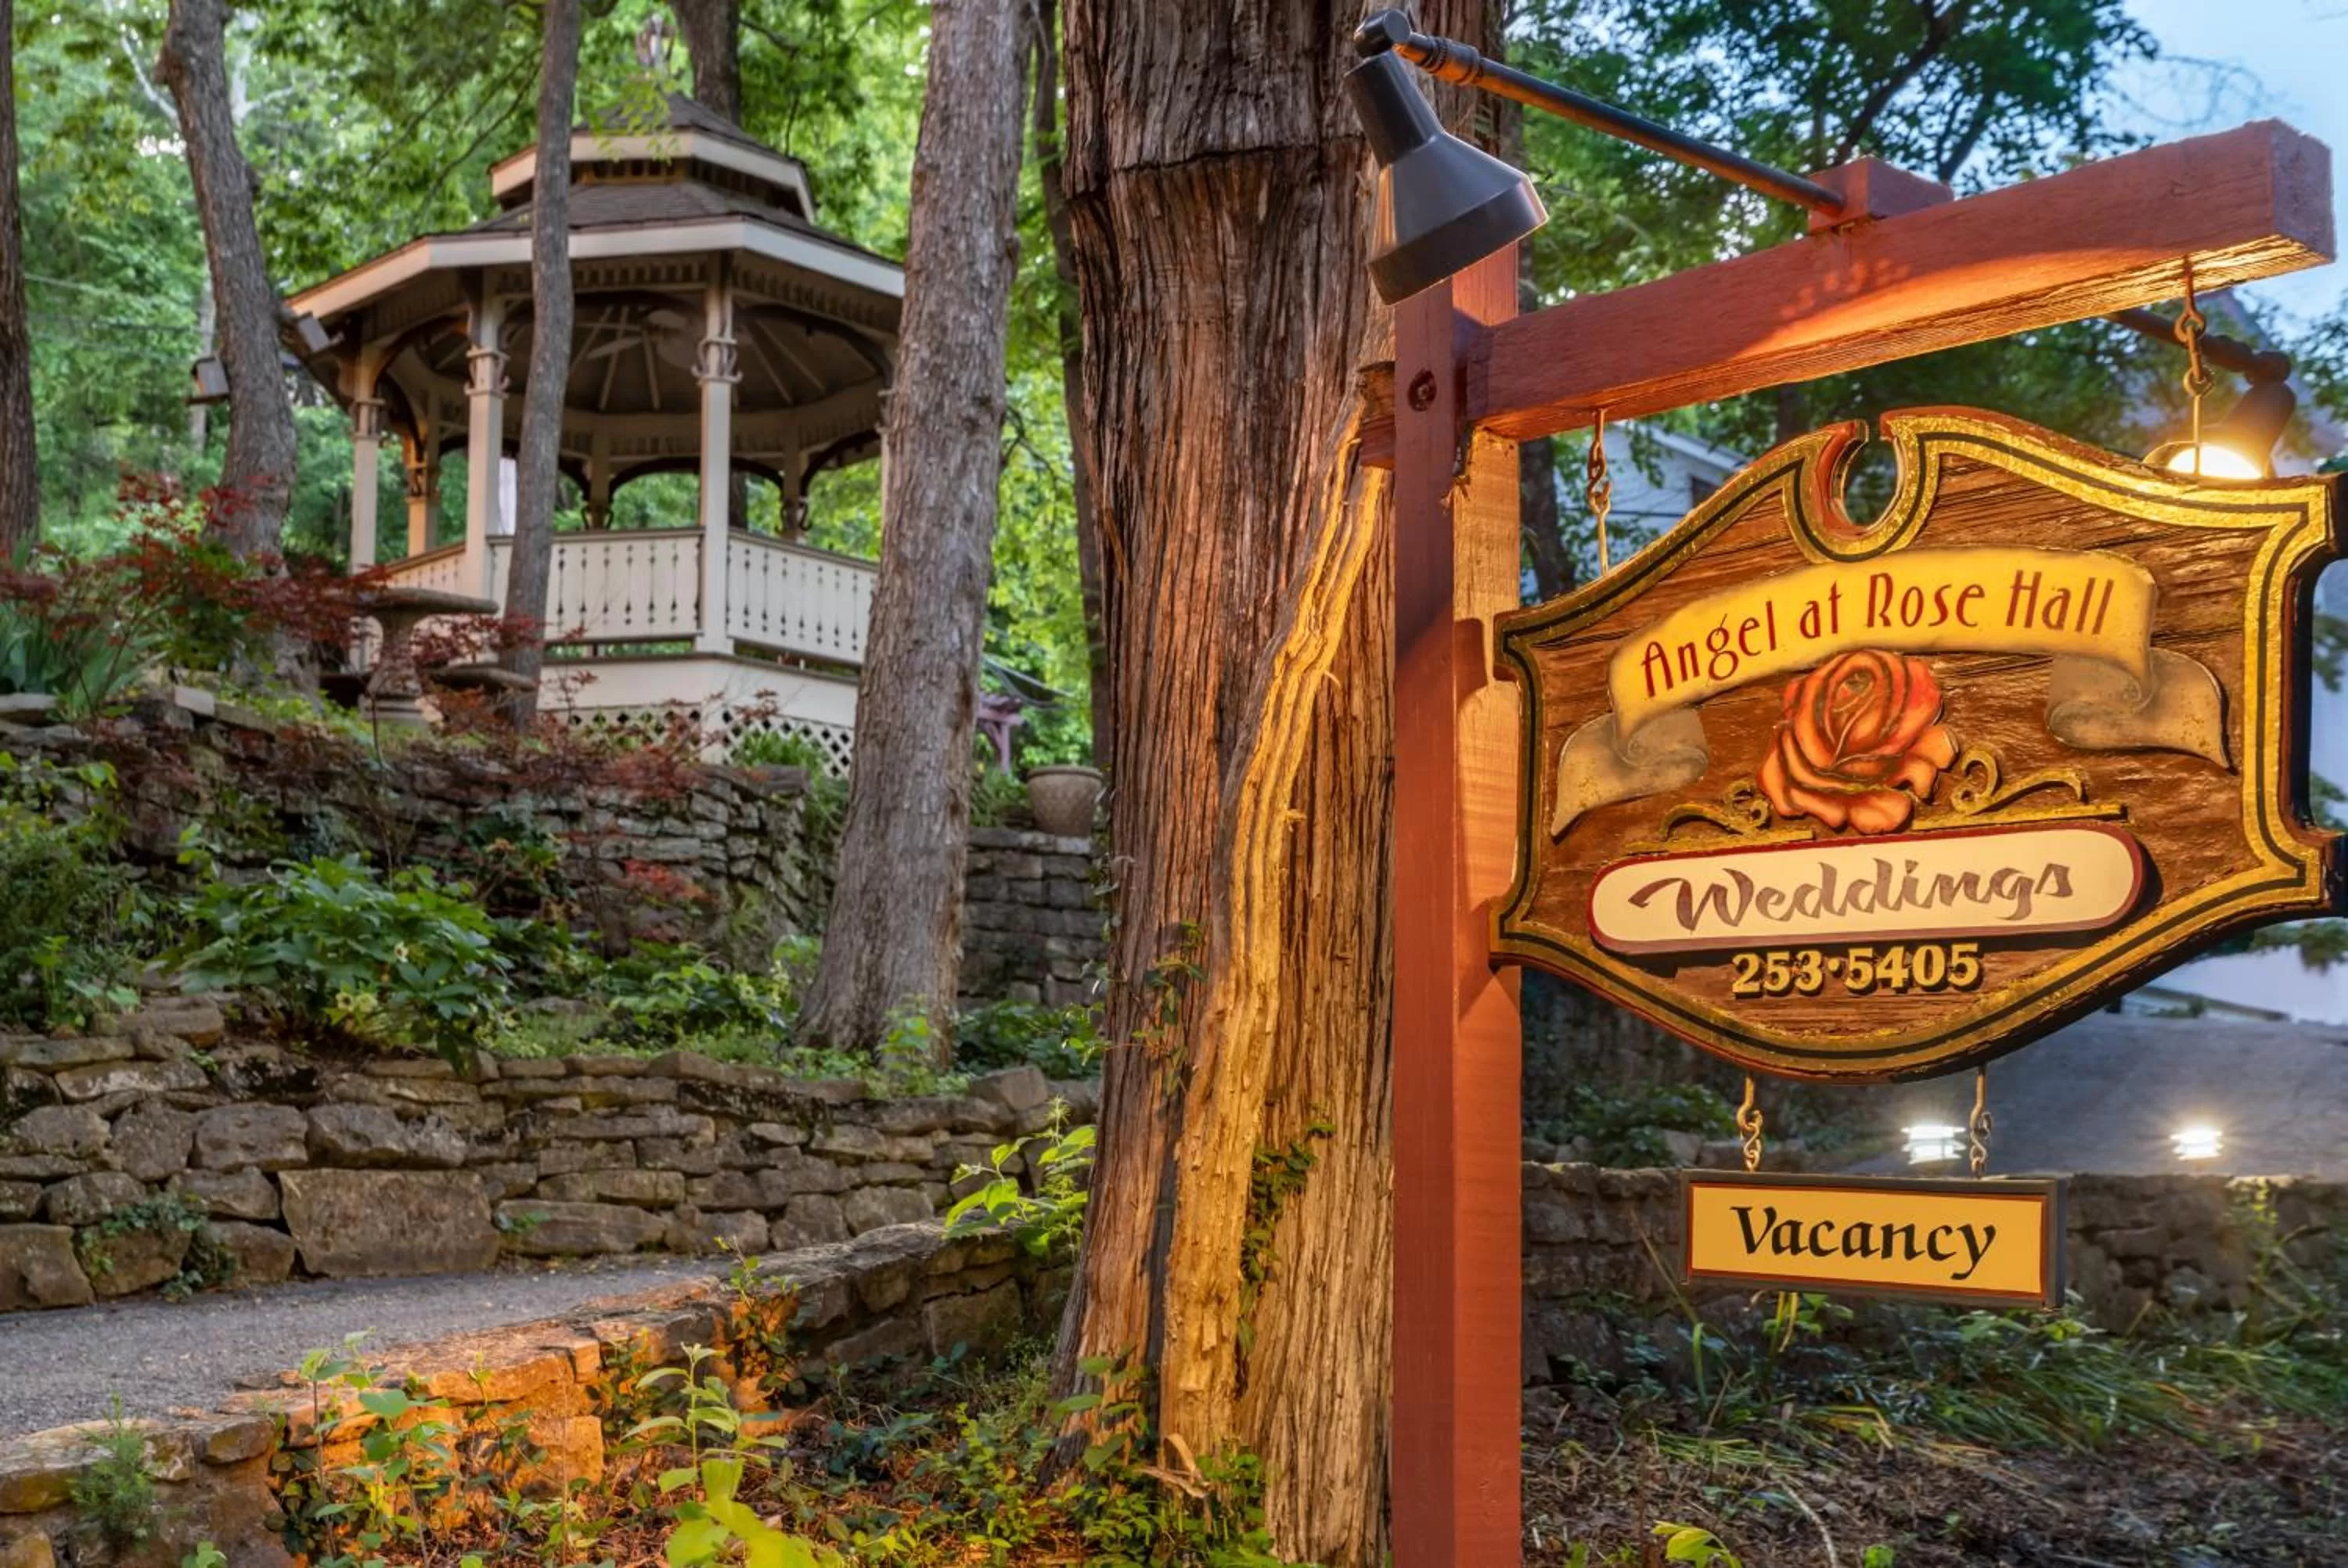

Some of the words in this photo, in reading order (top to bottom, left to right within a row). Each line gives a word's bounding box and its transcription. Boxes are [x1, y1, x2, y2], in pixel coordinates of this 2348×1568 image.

[1641, 601, 1777, 696] Angel
[1800, 582, 1842, 638] at
[1867, 573, 1985, 628] Rose
[2007, 570, 2114, 635] Hall
[1629, 858, 2073, 931] Weddings
[1730, 1206, 1997, 1280] Vacancy
